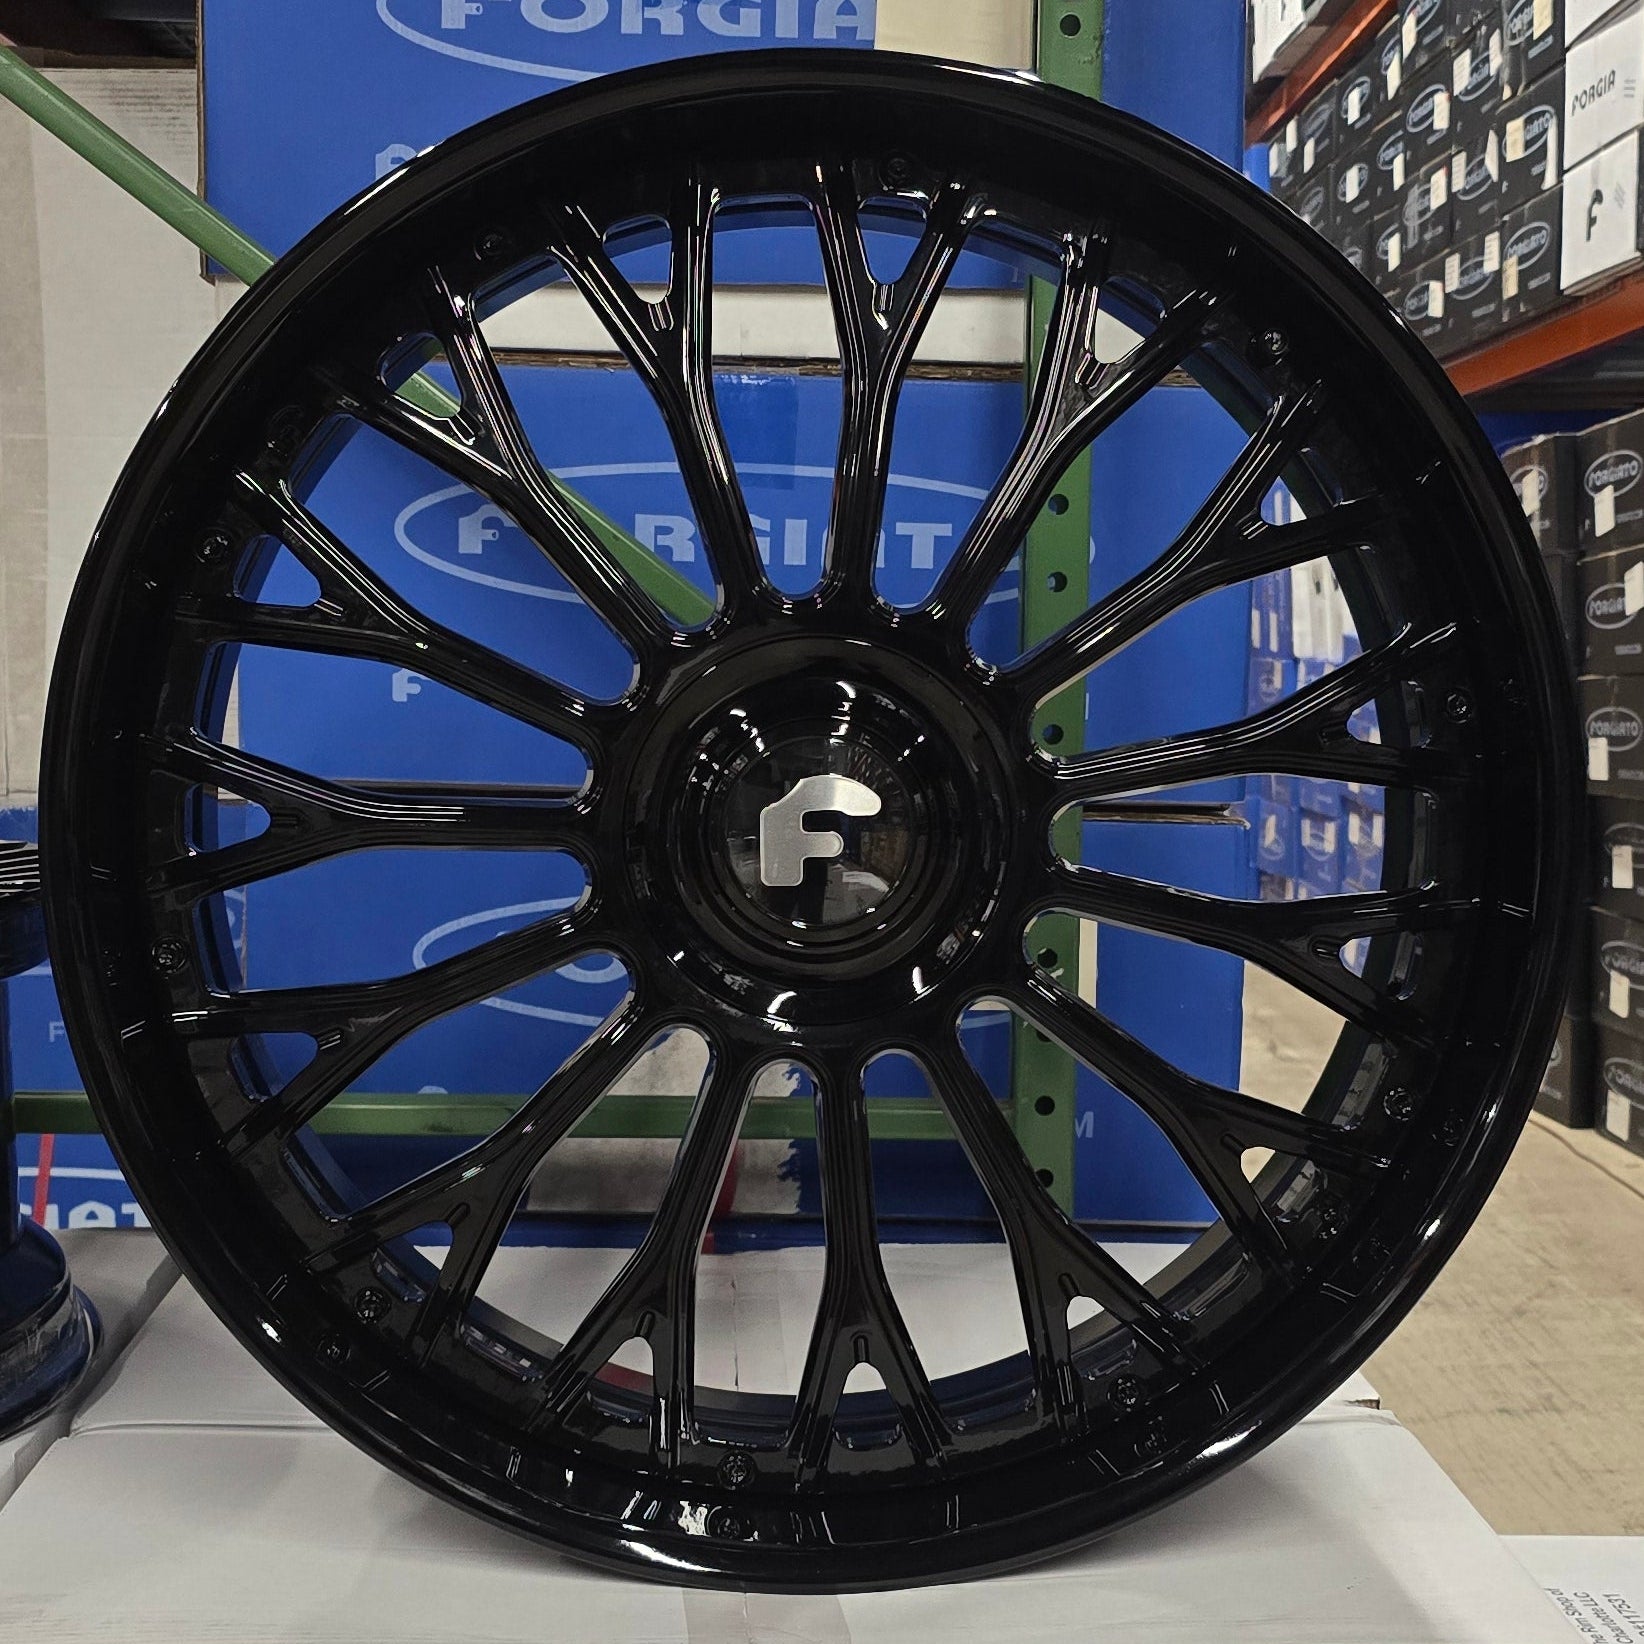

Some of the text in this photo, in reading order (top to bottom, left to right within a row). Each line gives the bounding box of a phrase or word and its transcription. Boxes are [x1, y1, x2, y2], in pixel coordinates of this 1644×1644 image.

[1556, 1596, 1582, 1616] Shop
[1573, 1591, 1634, 1643] Charlotte LLC
